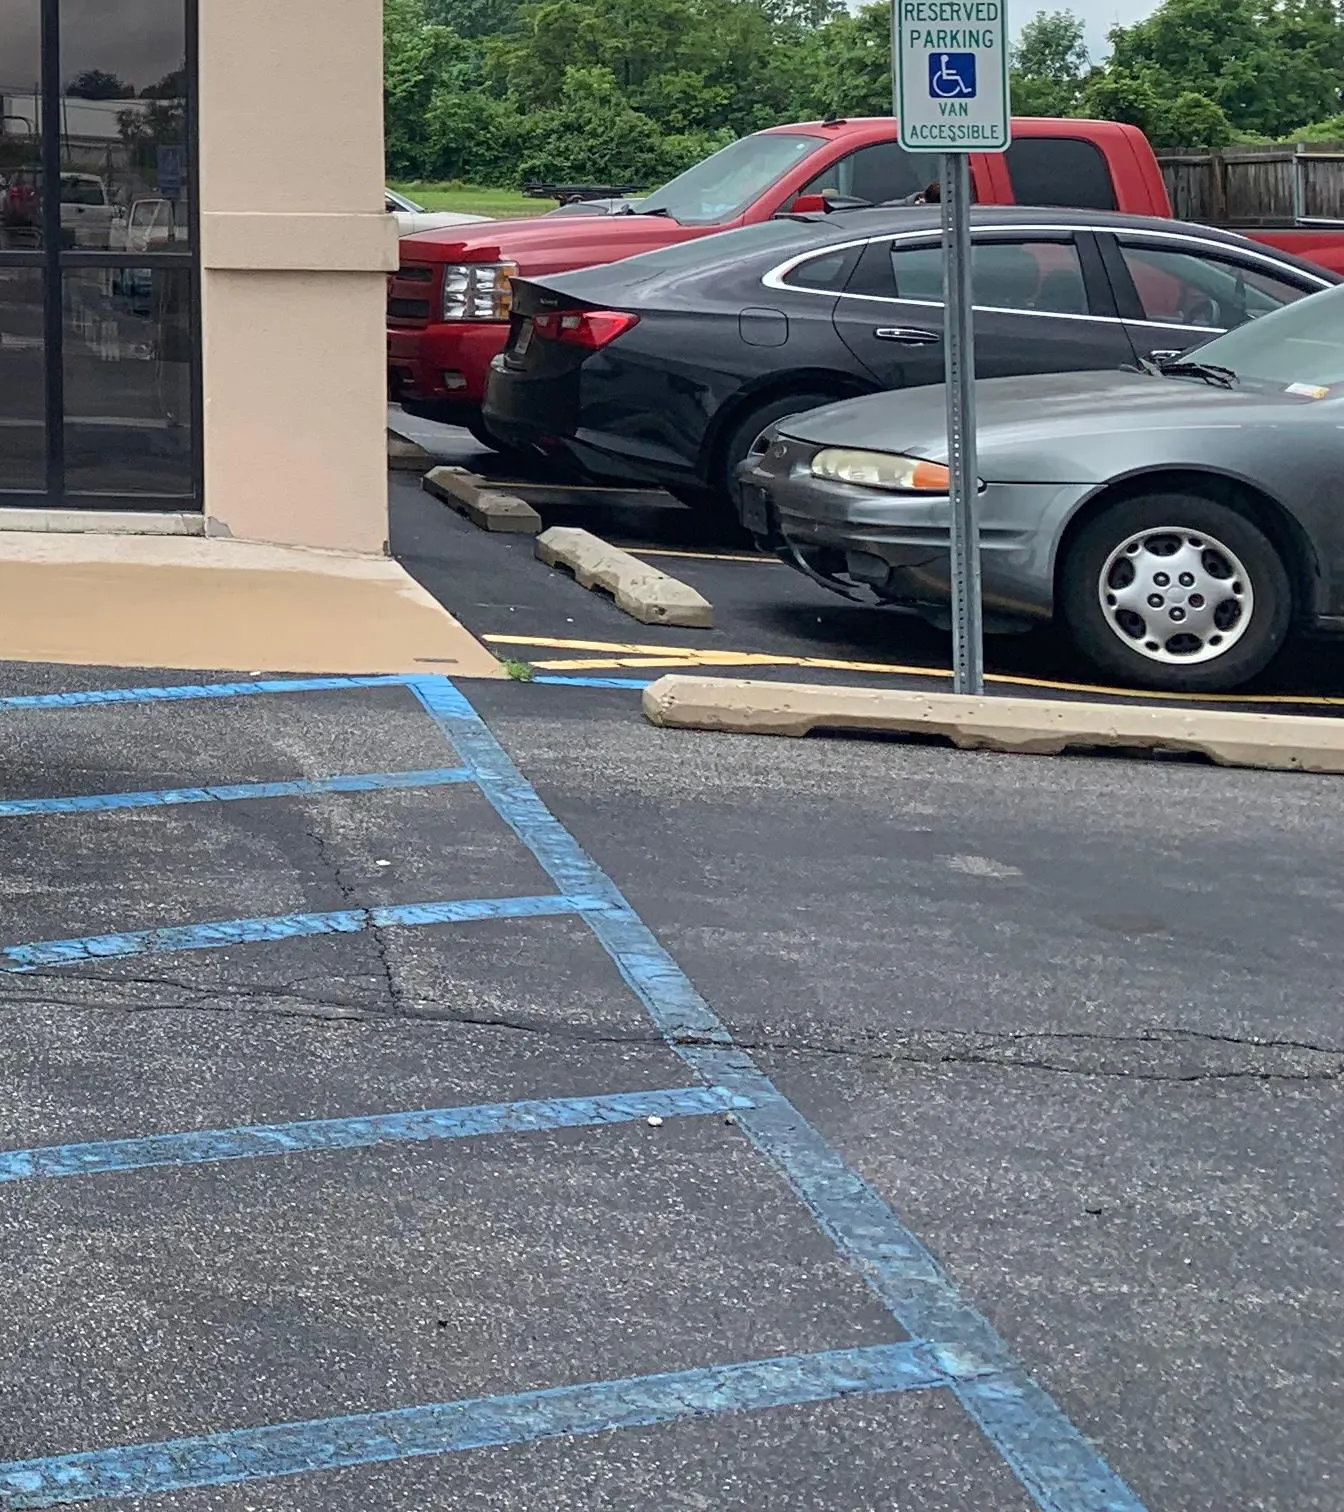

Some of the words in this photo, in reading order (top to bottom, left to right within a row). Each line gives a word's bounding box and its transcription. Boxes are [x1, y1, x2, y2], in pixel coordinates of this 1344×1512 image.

[904, 2, 999, 22] RESERVED
[910, 29, 994, 49] PARKING
[939, 102, 969, 117] VAN
[910, 124, 999, 140] ACCESSIBLE
